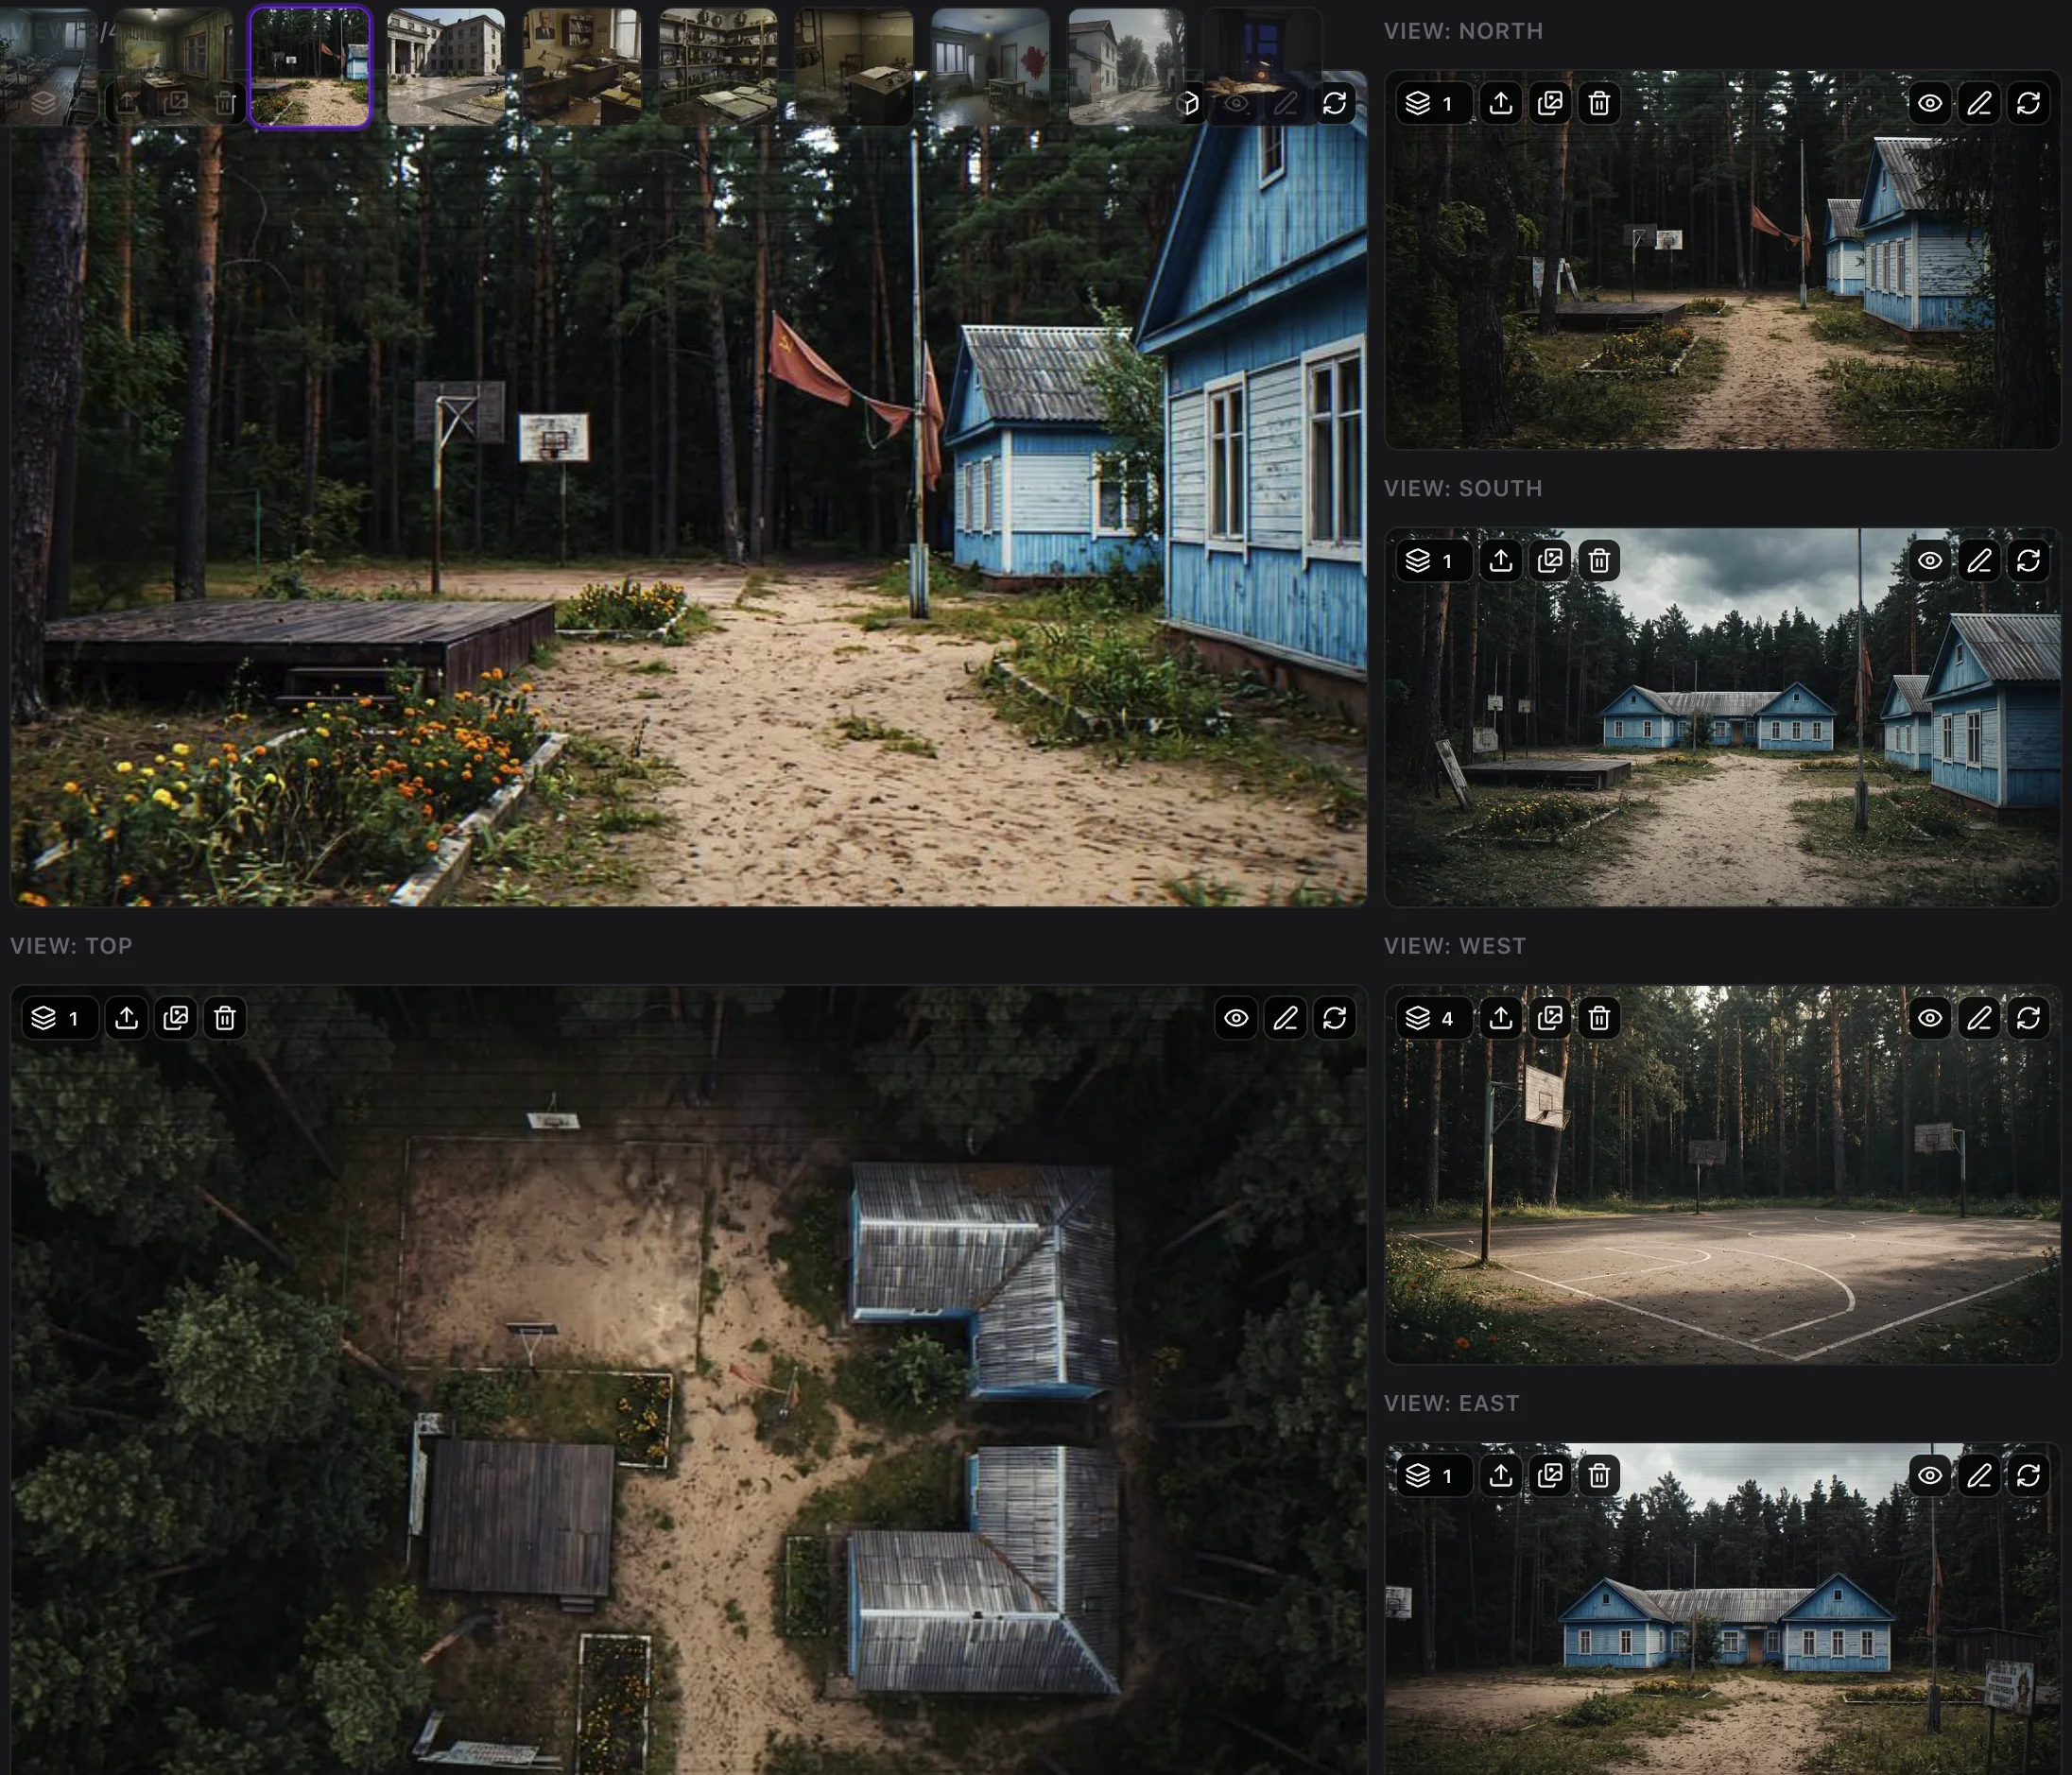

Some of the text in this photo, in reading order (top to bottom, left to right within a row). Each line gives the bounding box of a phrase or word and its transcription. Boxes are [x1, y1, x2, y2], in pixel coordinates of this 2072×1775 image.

[1384, 23, 1542, 39] VIEW: NORTH
[1442, 96, 1451, 112] 1
[1384, 480, 1542, 496] VIEW: SOUTH
[1442, 554, 1451, 569] 1
[10, 938, 132, 954] VIEW: TOP
[1384, 938, 1527, 954] VIEW: WEST
[69, 1011, 78, 1026] 1
[1442, 1011, 1454, 1026] 4
[1384, 1395, 1519, 1411] VIEW: EAST
[1442, 1469, 1451, 1484] 1
